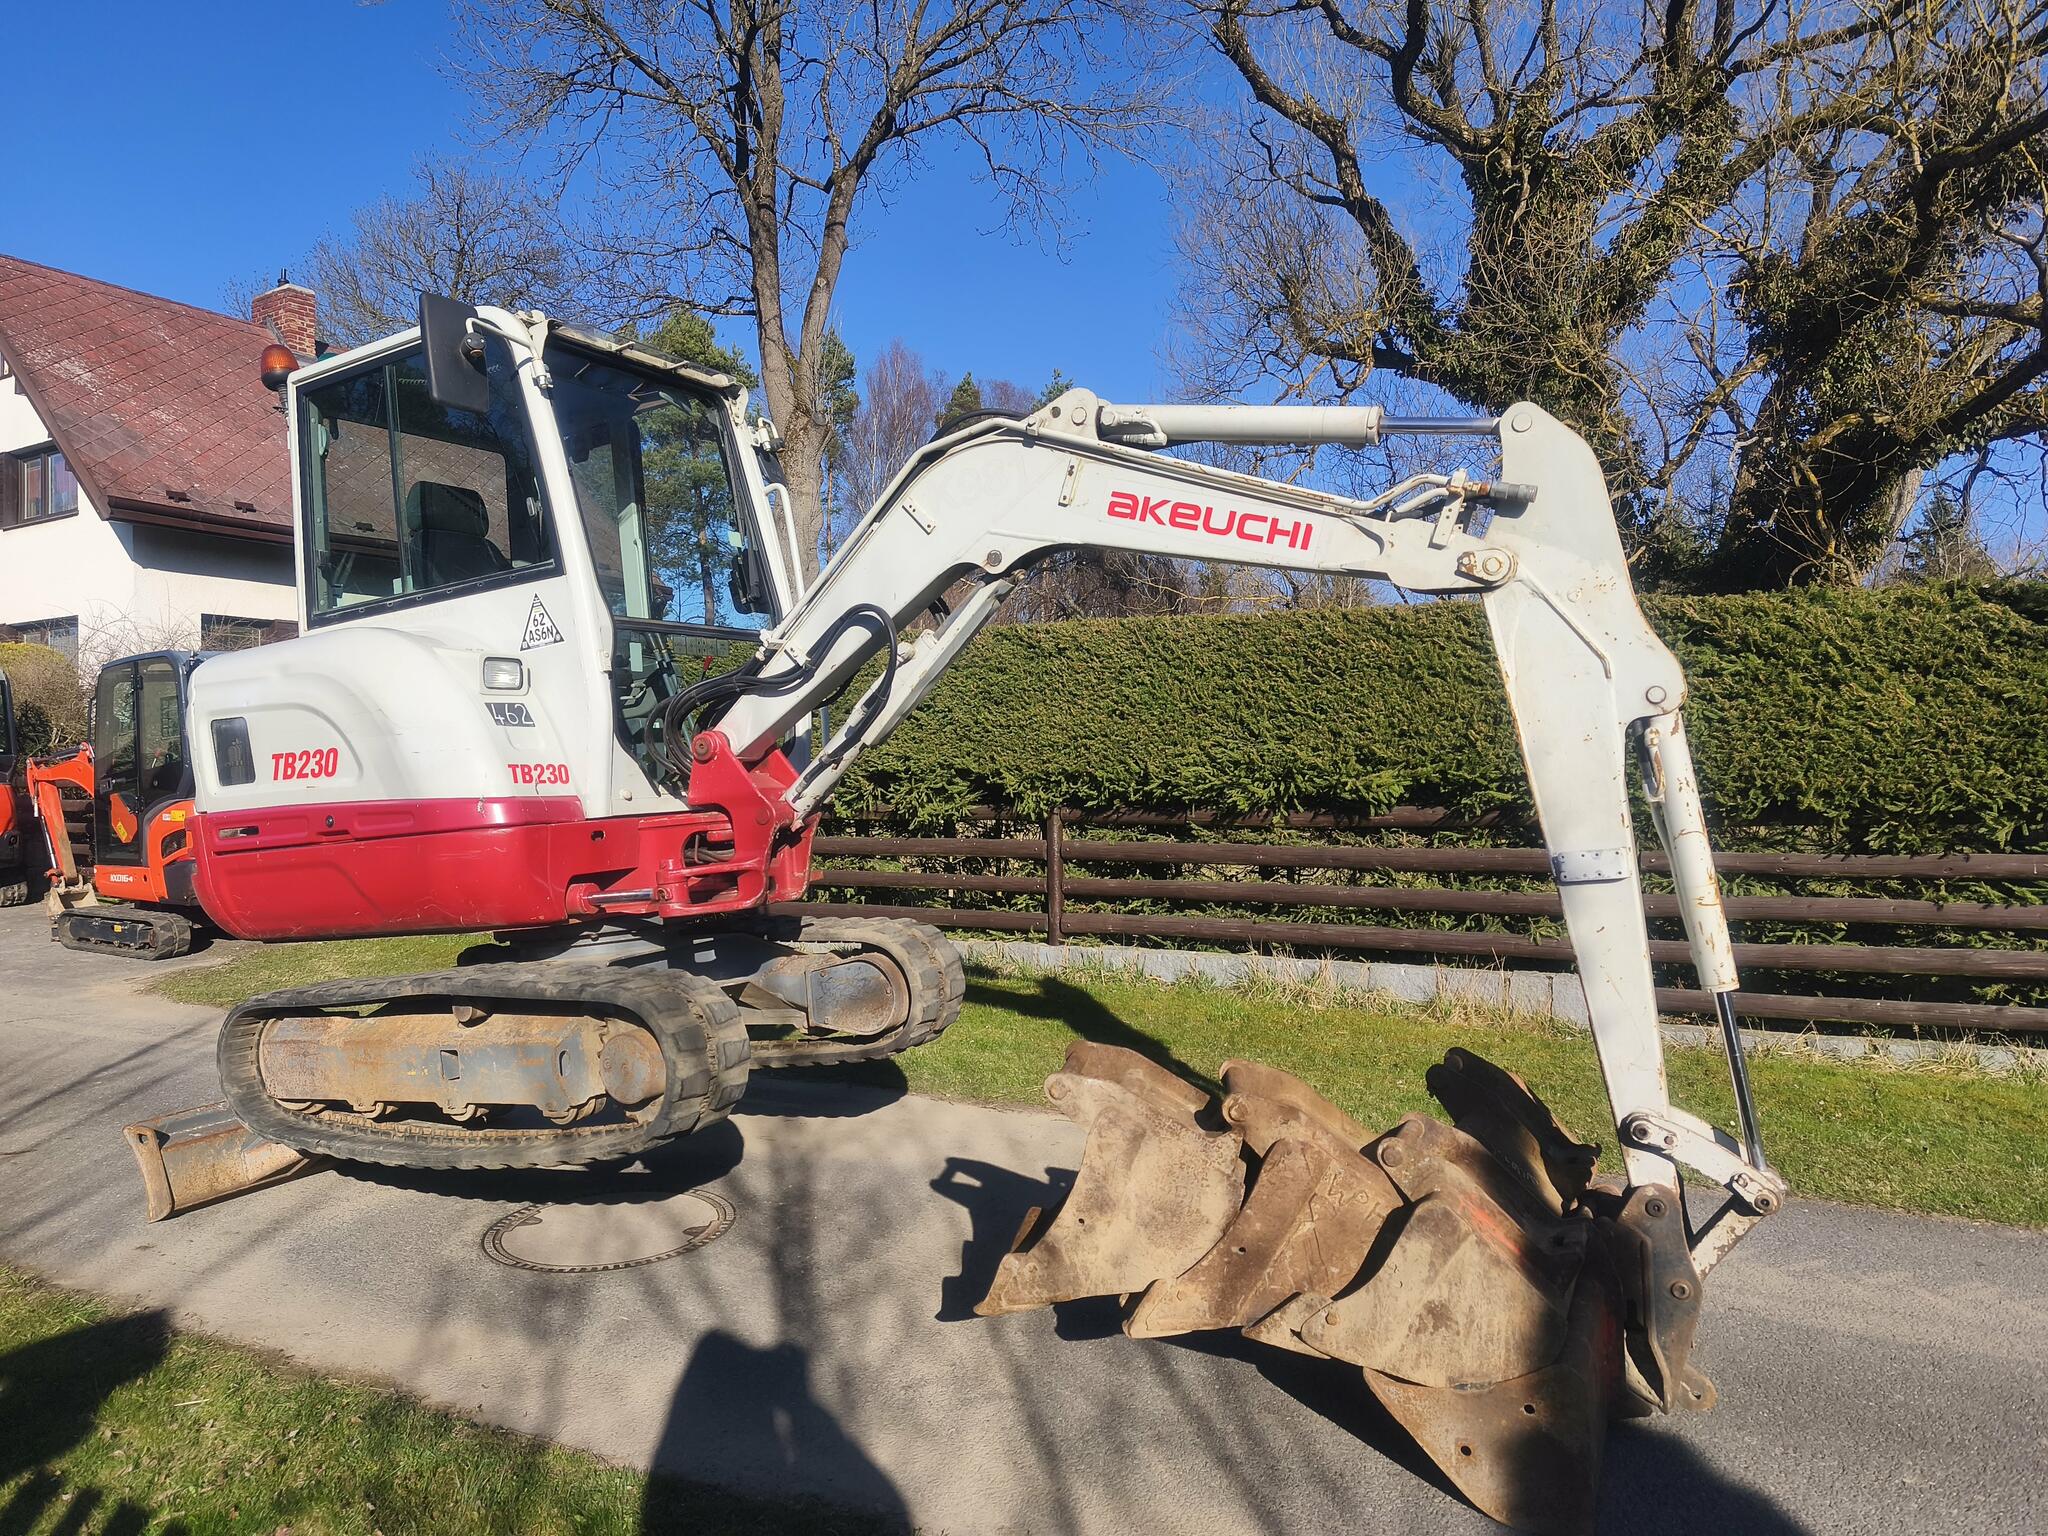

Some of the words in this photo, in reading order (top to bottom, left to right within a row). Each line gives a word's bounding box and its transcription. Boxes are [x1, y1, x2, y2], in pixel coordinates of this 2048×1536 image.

[533, 612, 546, 627] 62
[529, 625, 554, 643] AS6N
[491, 703, 534, 725] 462
[272, 747, 338, 780] TB230
[508, 763, 570, 785] TB230
